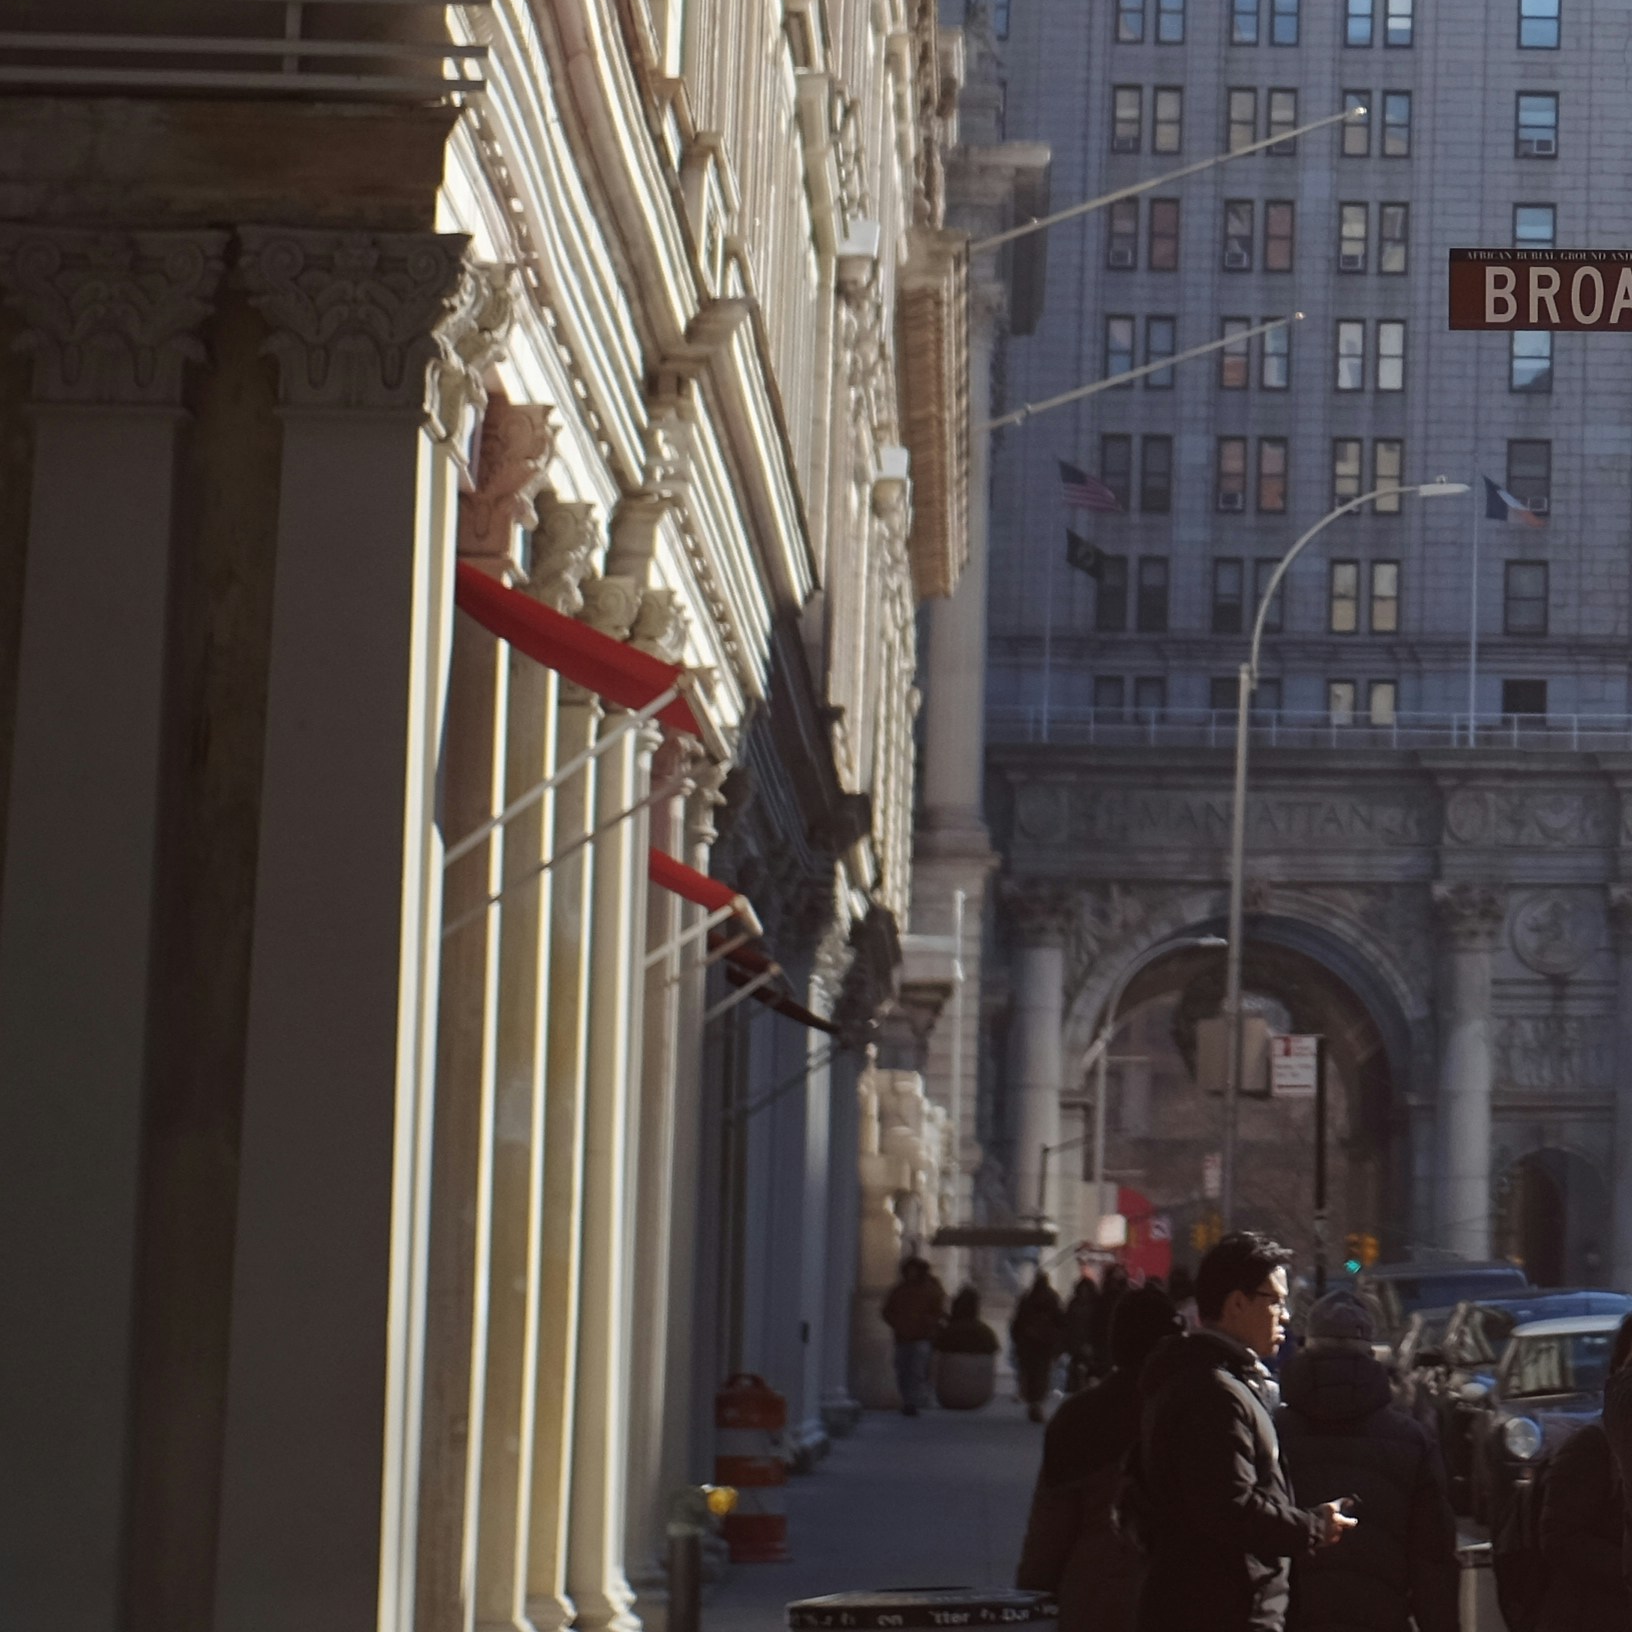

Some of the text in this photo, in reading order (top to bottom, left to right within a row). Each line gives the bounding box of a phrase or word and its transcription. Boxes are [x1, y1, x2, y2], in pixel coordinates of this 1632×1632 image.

[1467, 251, 1512, 260] AFRICAN
[1517, 251, 1557, 260] BURIAL
[1560, 252, 1606, 261] GROUND
[1611, 252, 1632, 261] AND
[1138, 799, 1374, 833] MANATTAN
